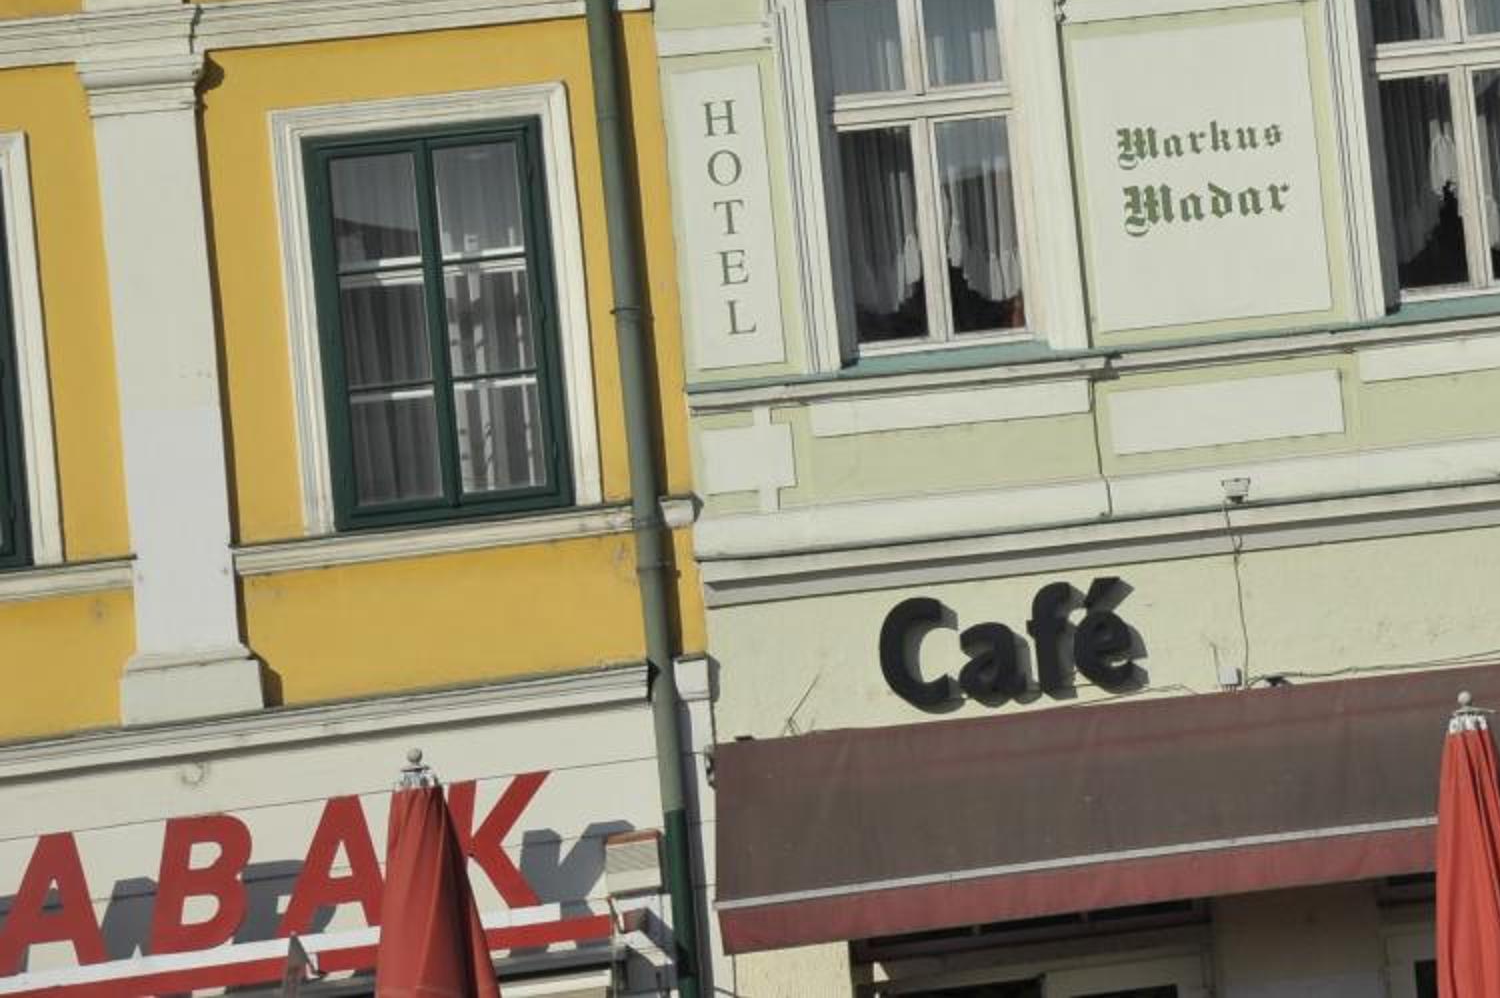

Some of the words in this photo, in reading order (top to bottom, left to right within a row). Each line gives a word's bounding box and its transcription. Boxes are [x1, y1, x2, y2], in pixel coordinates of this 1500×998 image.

[1116, 120, 1282, 170] Markus
[703, 100, 757, 335] HOTEL
[1123, 182, 1290, 237] Madar
[879, 576, 1149, 714] Café
